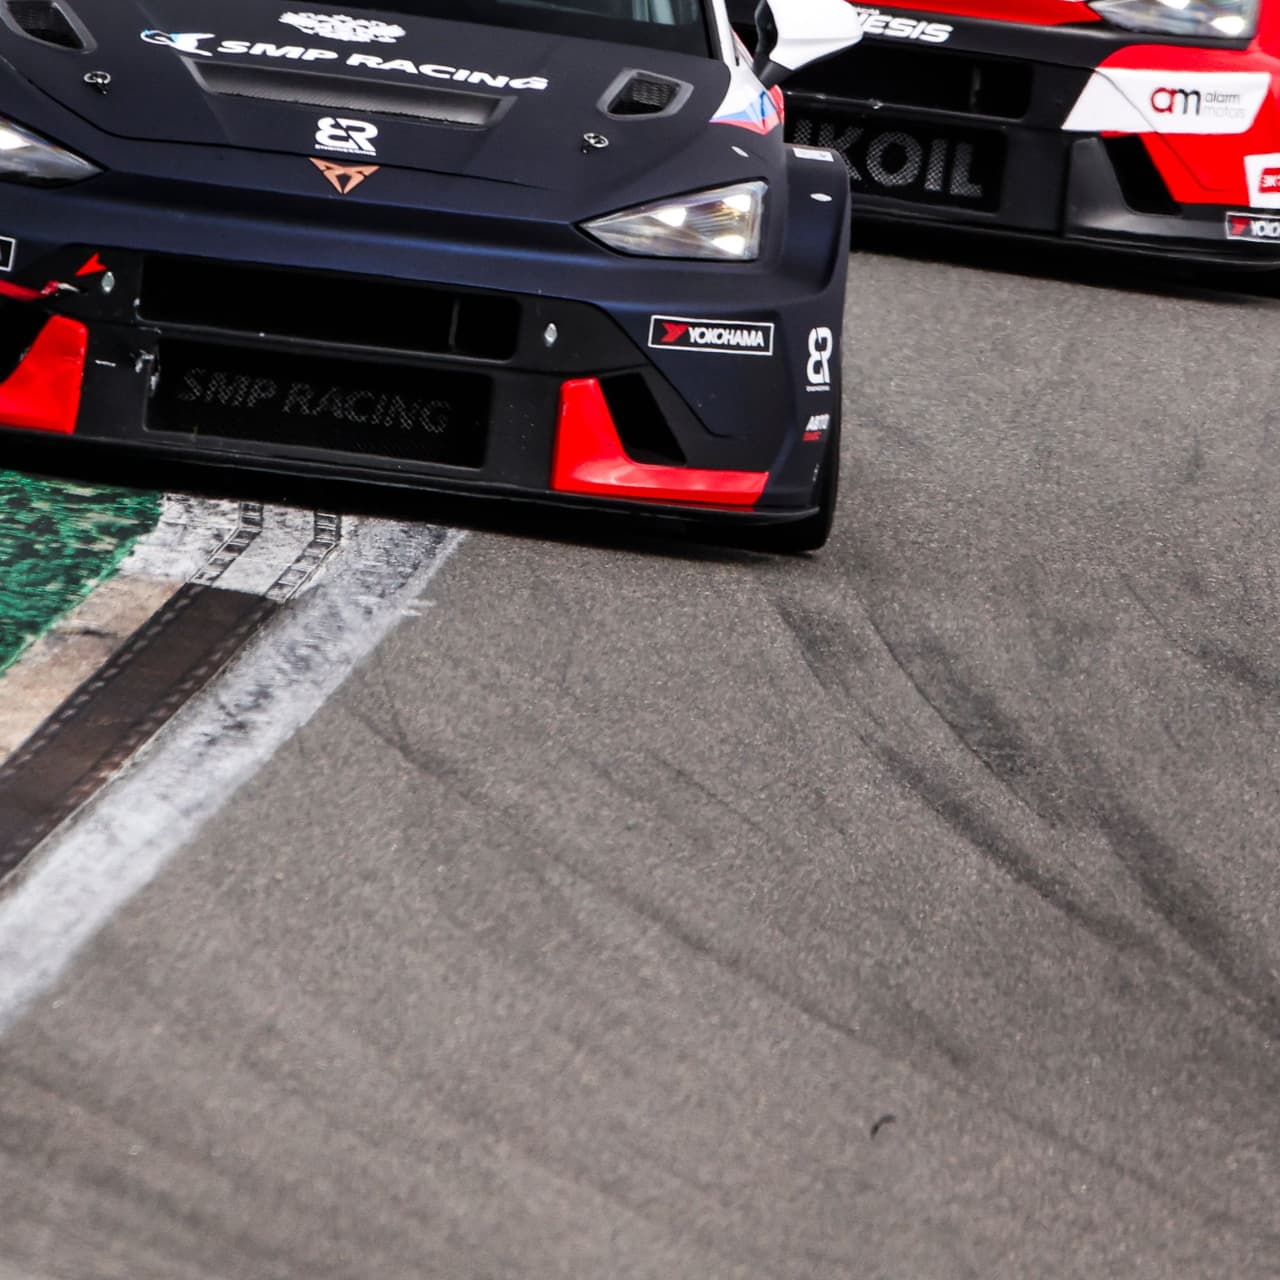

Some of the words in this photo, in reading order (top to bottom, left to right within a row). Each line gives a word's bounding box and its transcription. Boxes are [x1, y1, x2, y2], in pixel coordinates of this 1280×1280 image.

[217, 39, 339, 61] SMP
[345, 52, 549, 91] RACING
[794, 120, 983, 198] KOIL
[687, 327, 764, 348] YOKOHAMA
[178, 367, 277, 408] SMP
[282, 382, 451, 434] RACING
